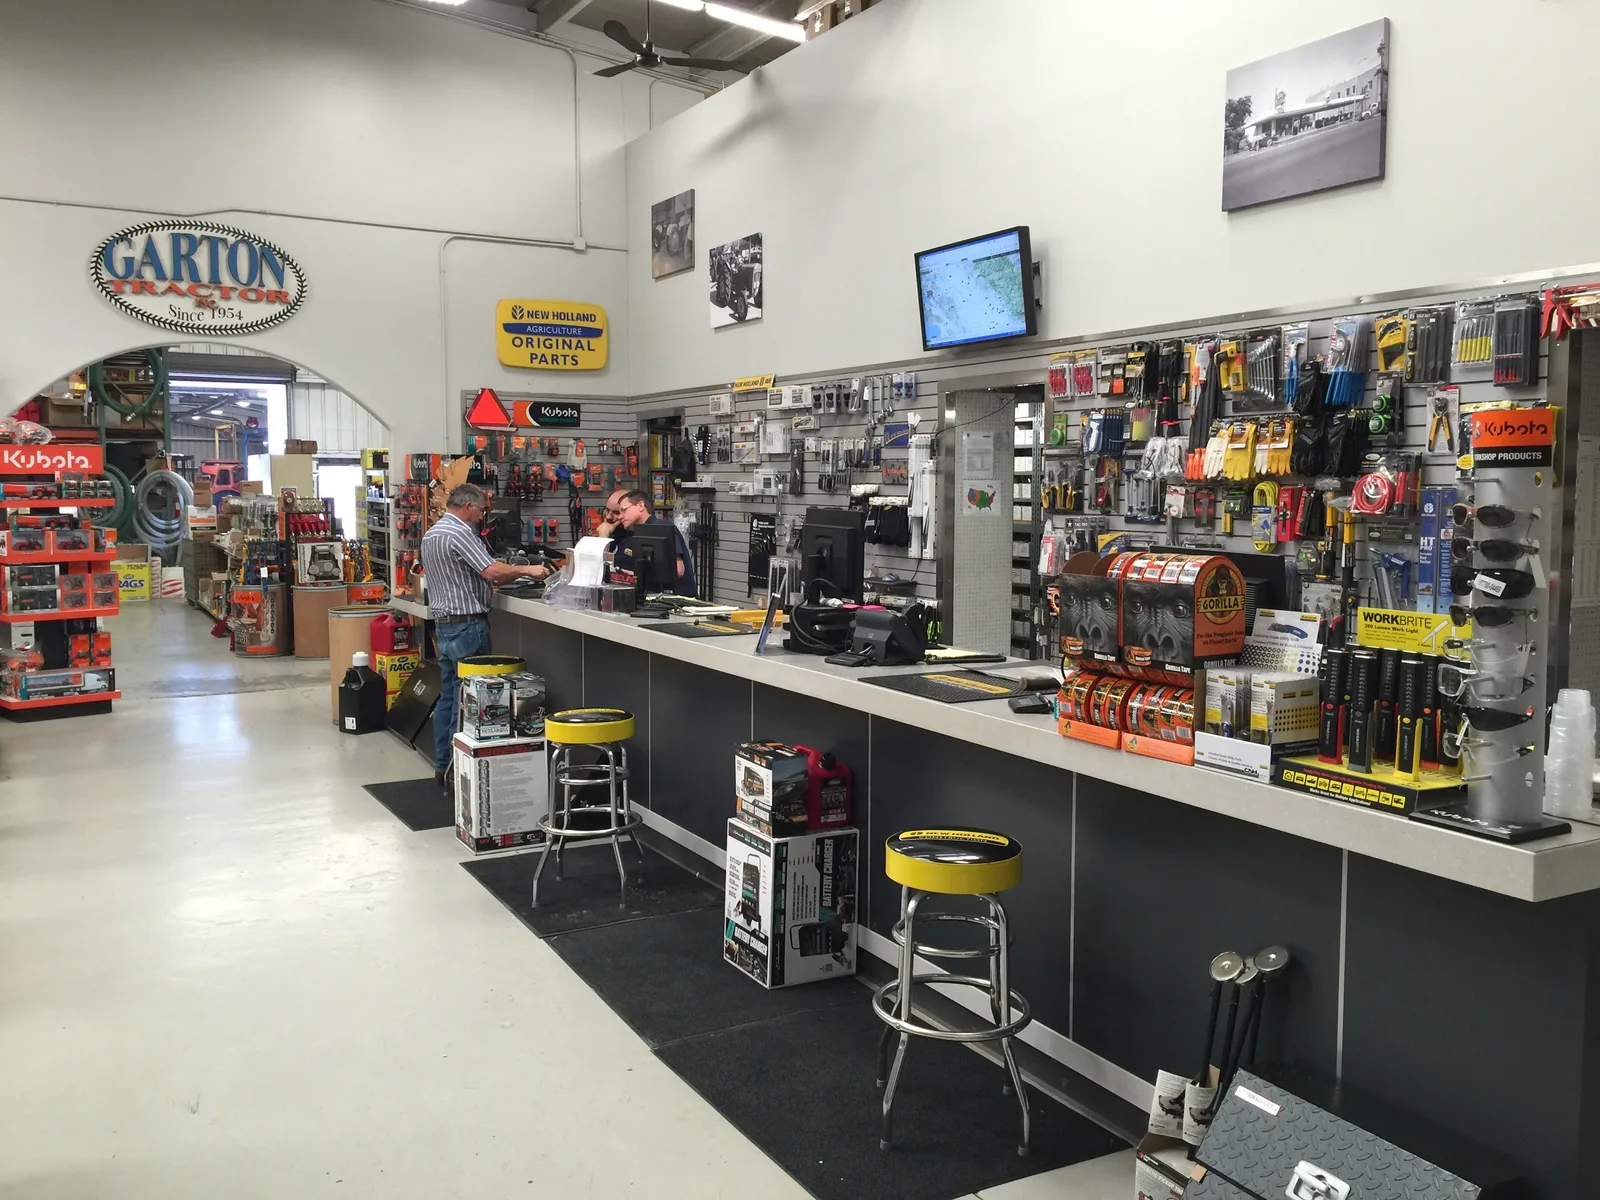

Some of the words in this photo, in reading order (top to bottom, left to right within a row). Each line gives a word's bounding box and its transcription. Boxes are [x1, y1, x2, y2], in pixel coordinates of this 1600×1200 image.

[103, 232, 287, 289] GARTON
[105, 279, 290, 304] TRACTOR
[168, 304, 204, 322] Since
[210, 307, 243, 321] 1954
[527, 309, 550, 320] NEW
[551, 311, 597, 323] HOLLAND
[526, 325, 582, 336] AGRICULTURE
[511, 336, 596, 352] ORIGINAL
[529, 352, 579, 366] PARTS
[541, 406, 578, 418] Kubota
[1484, 420, 1548, 437] Kubota
[3, 449, 89, 469] Kubota
[1498, 451, 1542, 461] PRODUCTS
[1420, 536, 1435, 546] HT
[1202, 597, 1240, 610] GORILLA
[1363, 611, 1432, 629] WORKBRITE
[1094, 652, 1107, 661] GORILLA
[389, 661, 415, 672] RAGS
[1165, 664, 1180, 673] GORILLA
[1181, 665, 1191, 673] TAPE
[1203, 659, 1224, 669] GORILLA
[1224, 659, 1237, 667] TAPE
[1430, 809, 1489, 826] Kubota
[952, 832, 1000, 840] HOLLAND
[823, 838, 834, 874] CHARGER
[822, 875, 832, 907] BATTERY
[1174, 1185, 1184, 1196] TOO
